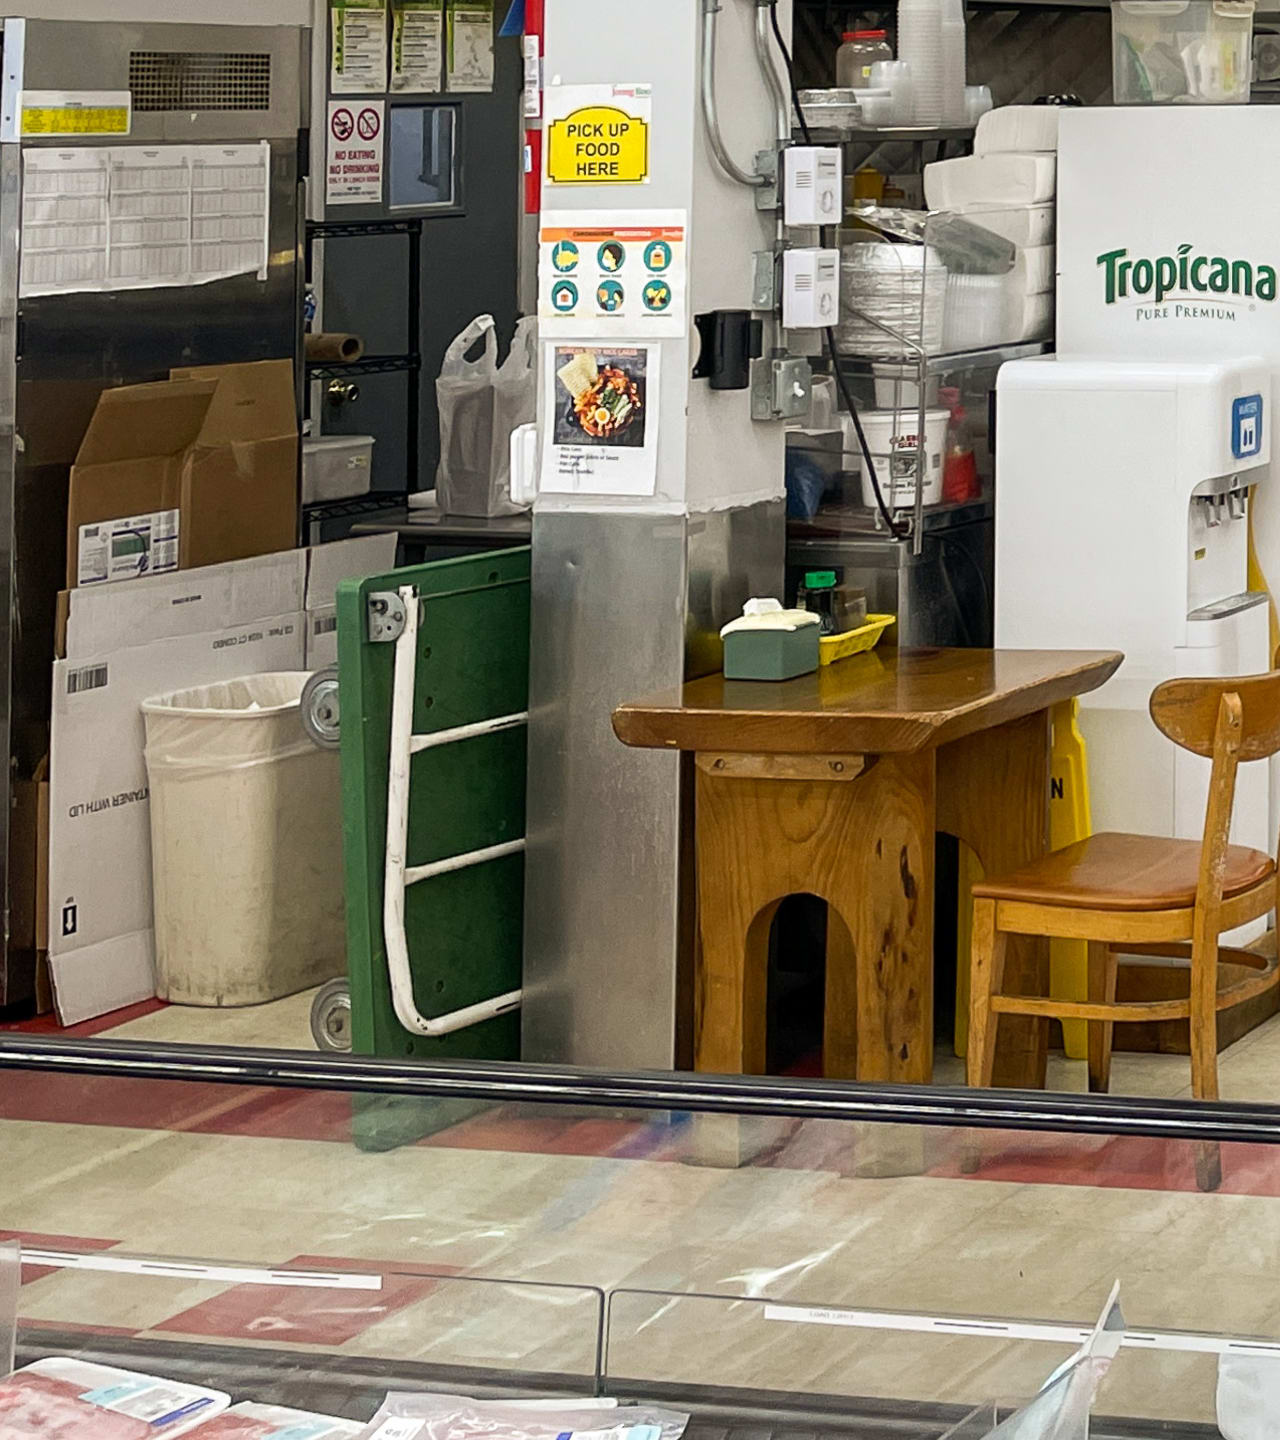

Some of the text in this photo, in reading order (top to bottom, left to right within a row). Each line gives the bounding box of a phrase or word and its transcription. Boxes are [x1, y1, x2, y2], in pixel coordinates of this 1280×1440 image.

[567, 124, 630, 138] PICK UP
[335, 150, 375, 159] NO EATING
[576, 143, 620, 157] FOOD
[329, 164, 380, 174] NO DRINKING
[576, 162, 619, 176] HERE
[1096, 244, 1278, 305] Tropicana
[1136, 305, 1236, 321] PURE PREMIUM
[69, 797, 110, 818] WITH LID
